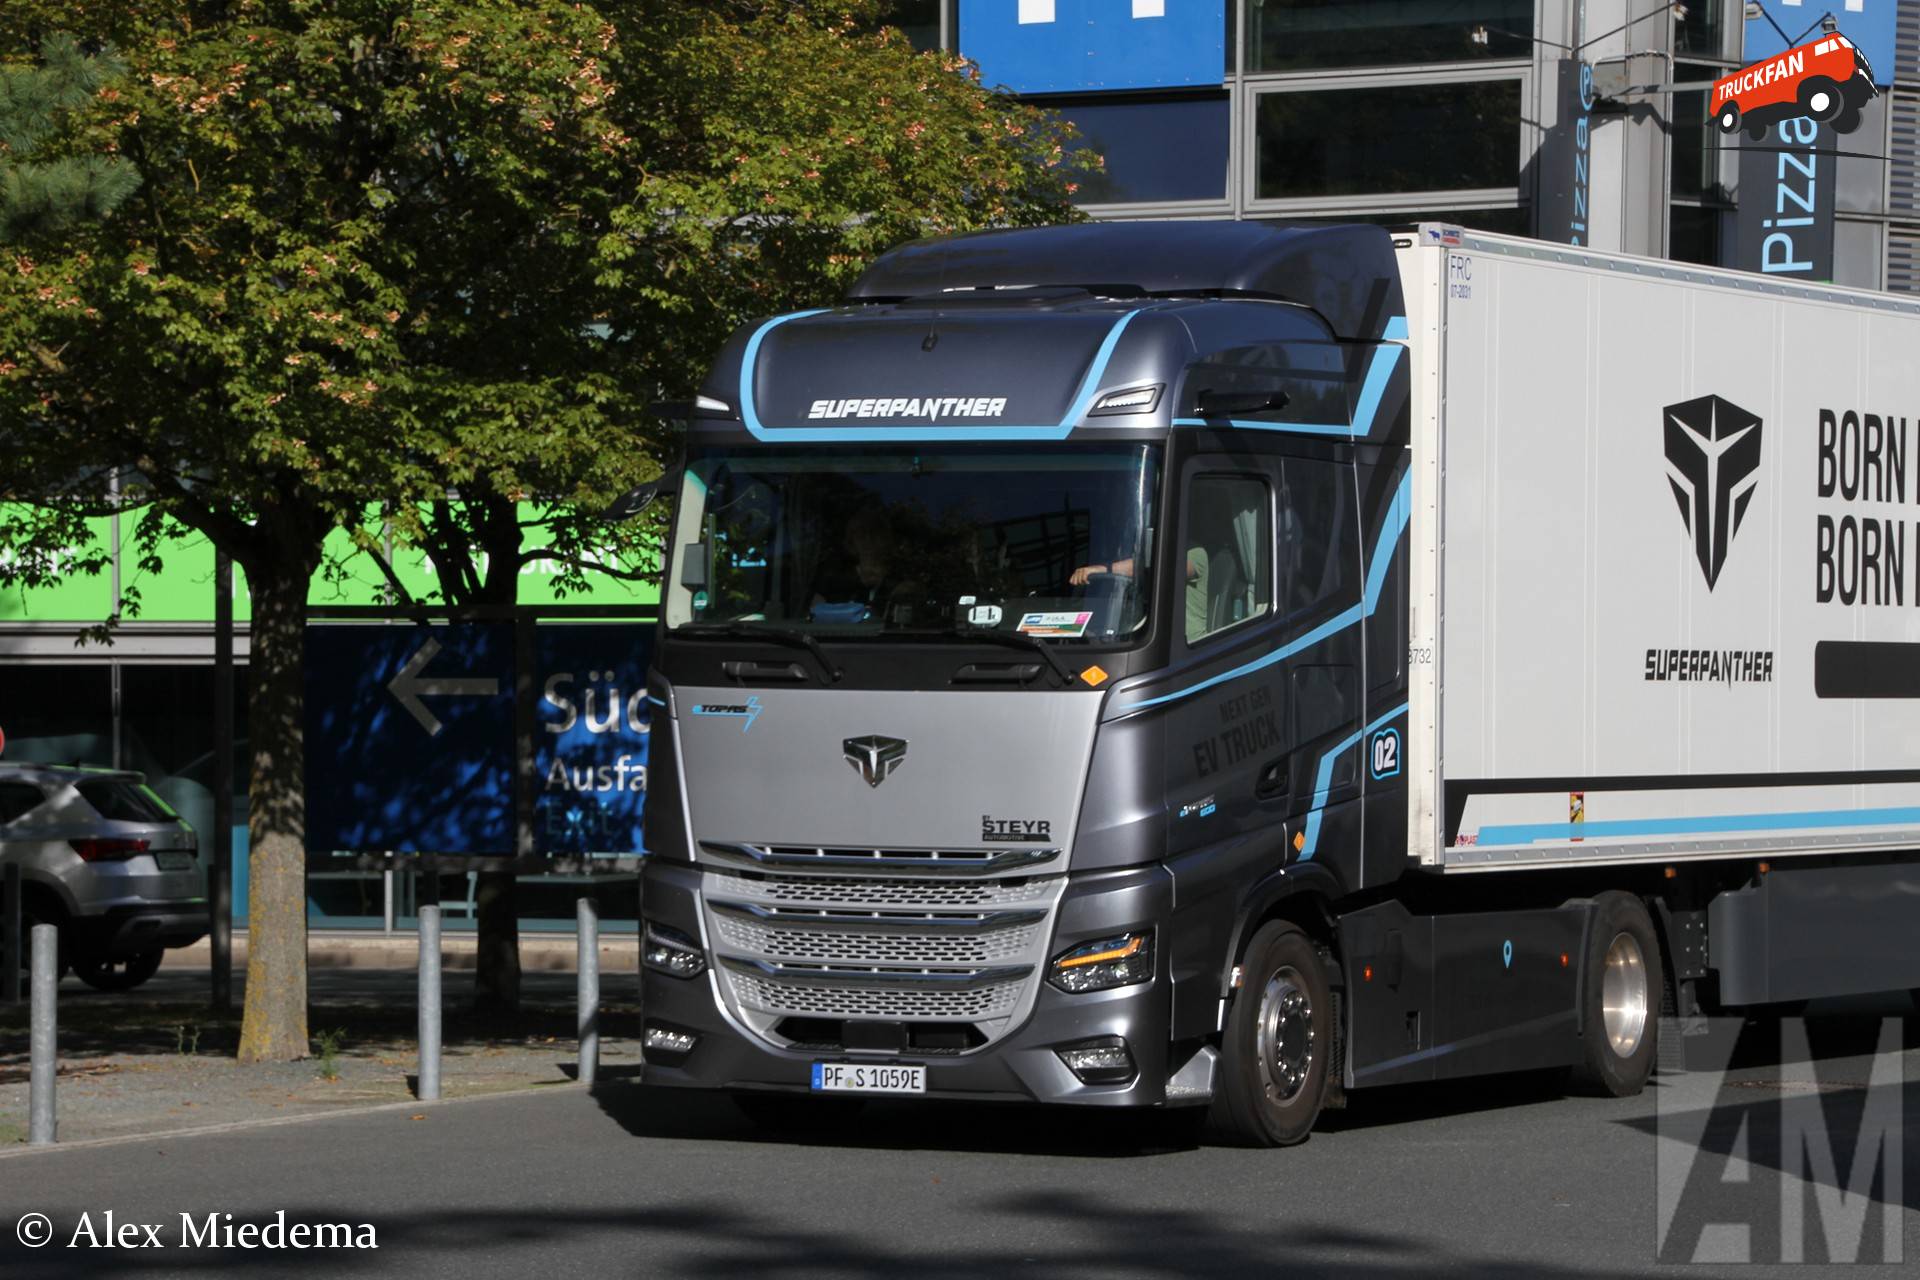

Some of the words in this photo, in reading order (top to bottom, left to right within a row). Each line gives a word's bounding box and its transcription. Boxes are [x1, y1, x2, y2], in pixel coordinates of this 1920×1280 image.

[1762, 116, 1818, 273] Pizza
[1450, 255, 1473, 281] FRC
[808, 397, 1007, 422] SUPERPANTHER
[1818, 408, 1906, 504] BORN
[1816, 514, 1905, 607] BORN
[1645, 649, 1773, 690] SUPERPANTHER
[1193, 737, 1219, 778] EV
[1220, 709, 1281, 766] TRUCK
[1374, 736, 1397, 771] 02
[545, 801, 616, 835] Exit
[982, 820, 1050, 833] STEYR
[825, 1067, 845, 1087] PF
[855, 1069, 866, 1088] S
[870, 1069, 921, 1090] 1059E
